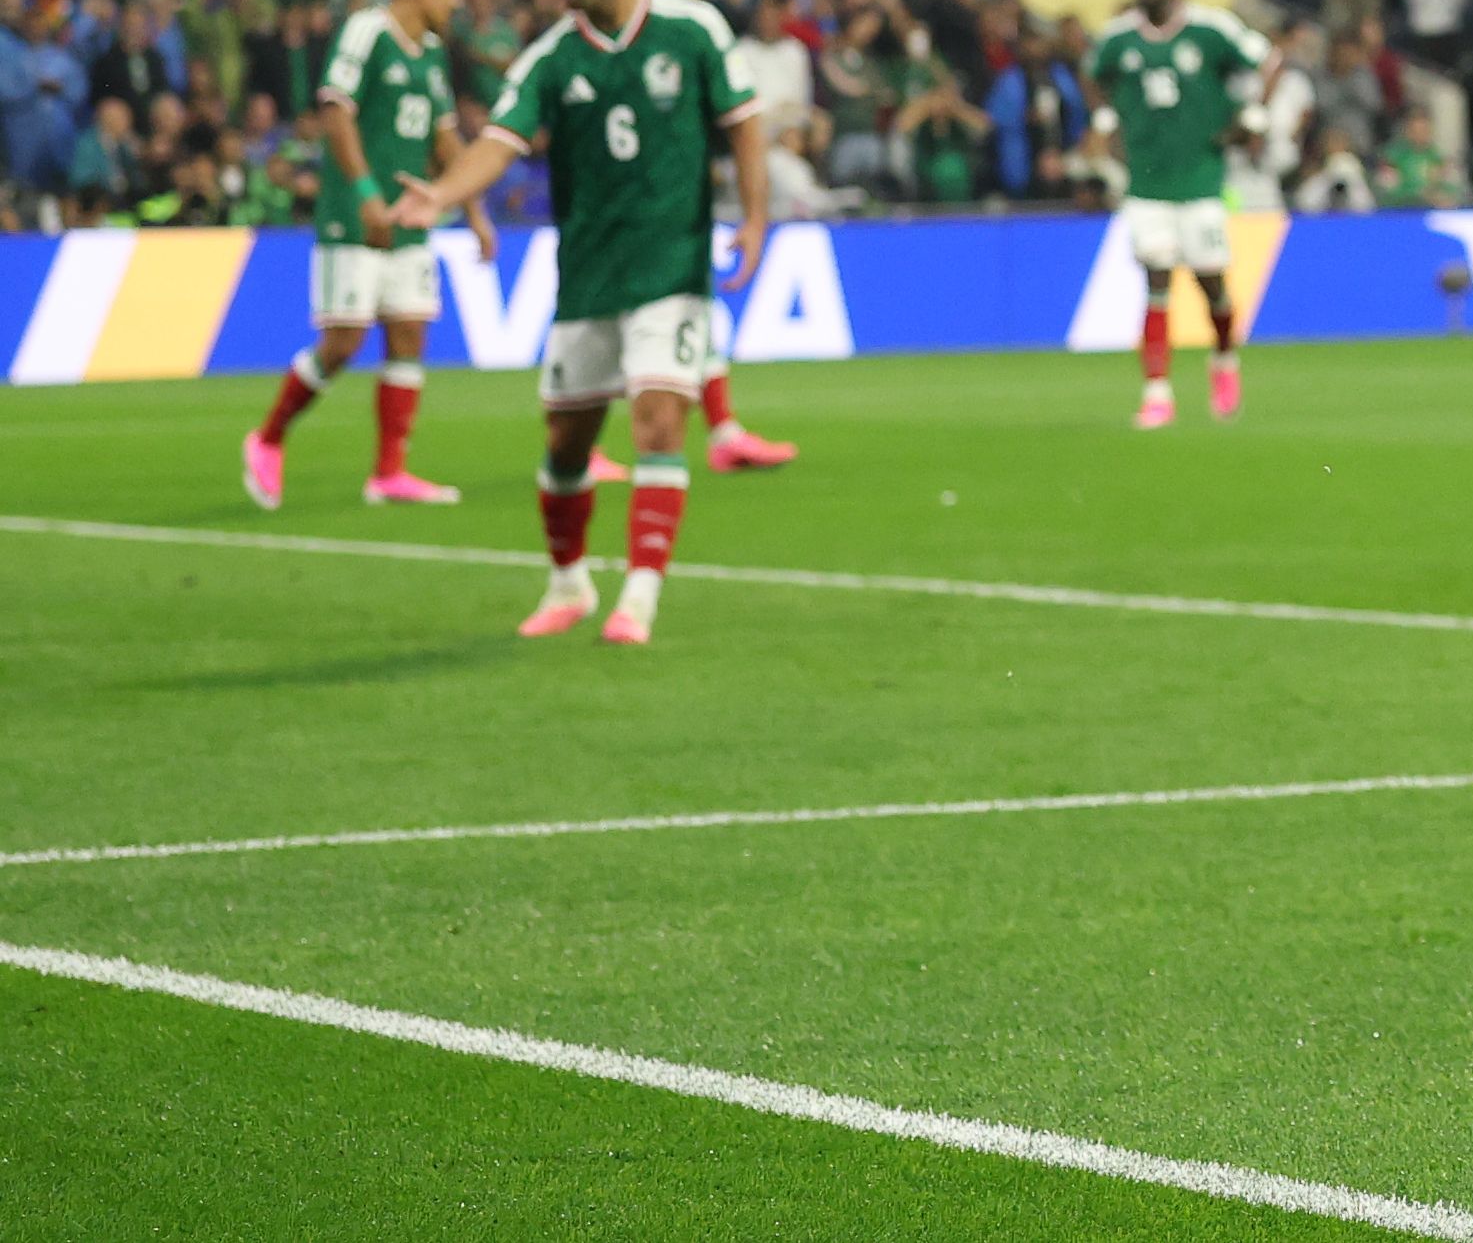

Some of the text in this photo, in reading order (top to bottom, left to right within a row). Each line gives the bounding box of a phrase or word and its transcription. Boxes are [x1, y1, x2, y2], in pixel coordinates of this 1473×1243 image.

[605, 104, 640, 162] 6
[431, 223, 854, 368] VA
[676, 317, 696, 366] 6
